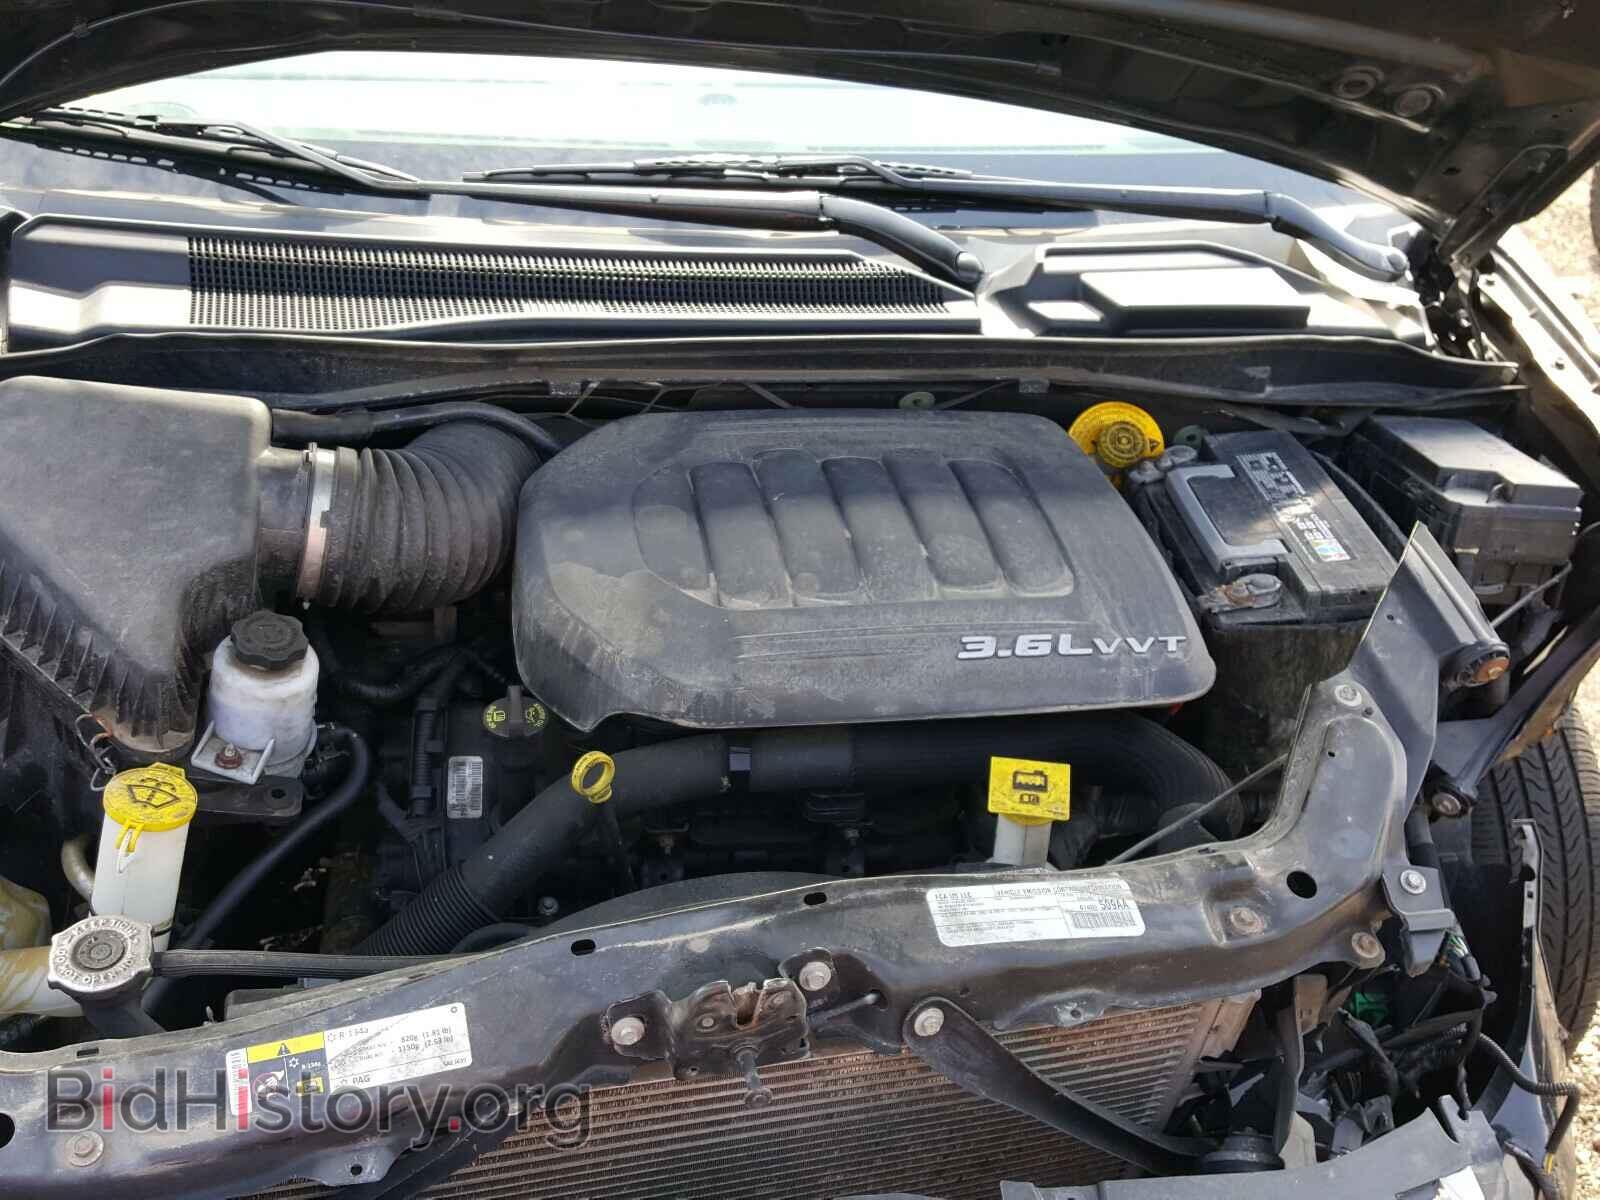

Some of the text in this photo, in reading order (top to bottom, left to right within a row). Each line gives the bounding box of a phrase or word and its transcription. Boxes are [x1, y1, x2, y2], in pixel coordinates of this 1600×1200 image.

[957, 633, 1188, 660] 3.6L VVT
[352, 1074, 372, 1085] PAG
